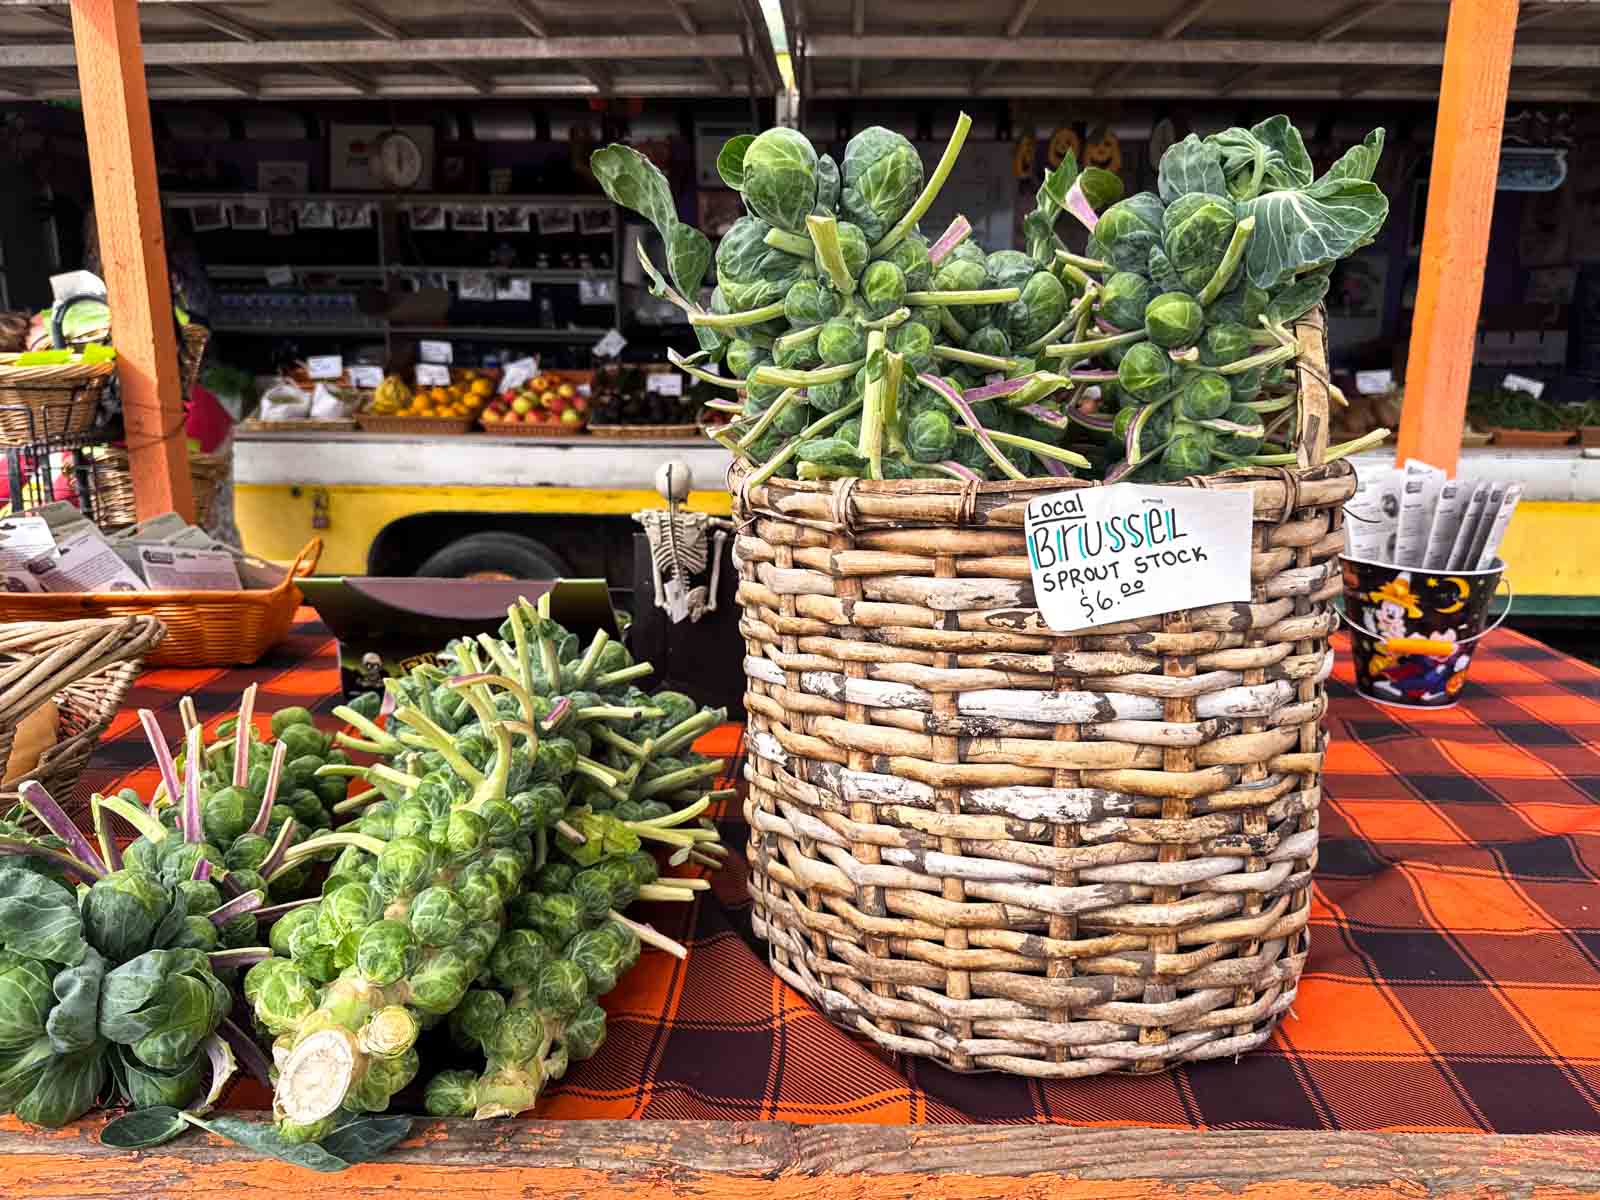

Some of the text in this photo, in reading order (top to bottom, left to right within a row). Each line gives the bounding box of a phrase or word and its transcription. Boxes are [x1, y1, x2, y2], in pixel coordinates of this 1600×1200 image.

[1028, 493, 1084, 520] Local
[1043, 546, 1208, 592] SPROUT STOCK
